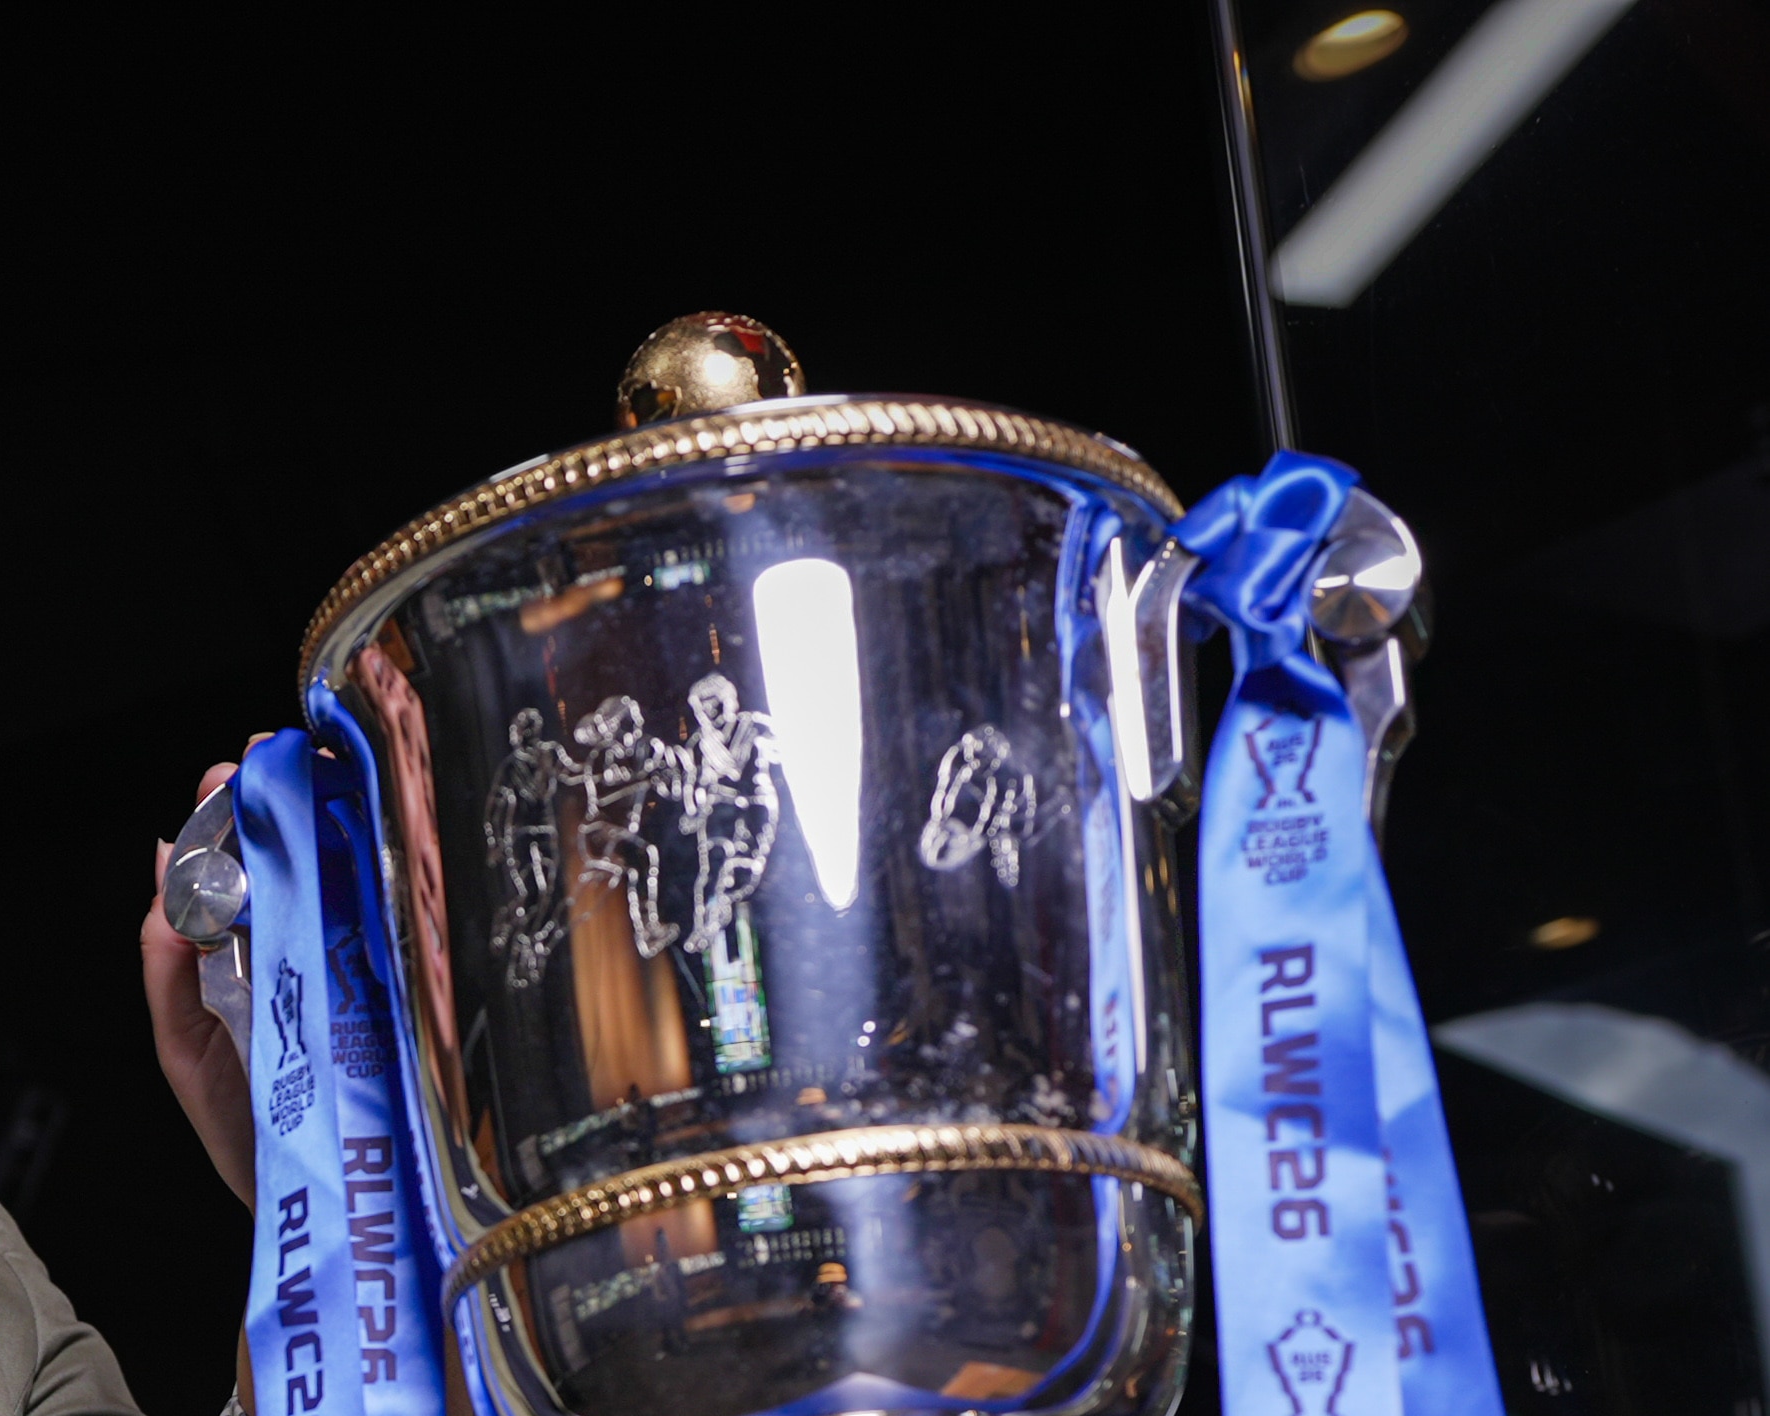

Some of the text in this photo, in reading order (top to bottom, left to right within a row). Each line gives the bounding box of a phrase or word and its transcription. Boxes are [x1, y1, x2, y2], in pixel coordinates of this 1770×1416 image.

[346, 1063, 384, 1079] CUP
[1259, 942, 1329, 1242] RLWC26
[342, 1134, 396, 1384] RLWC26
